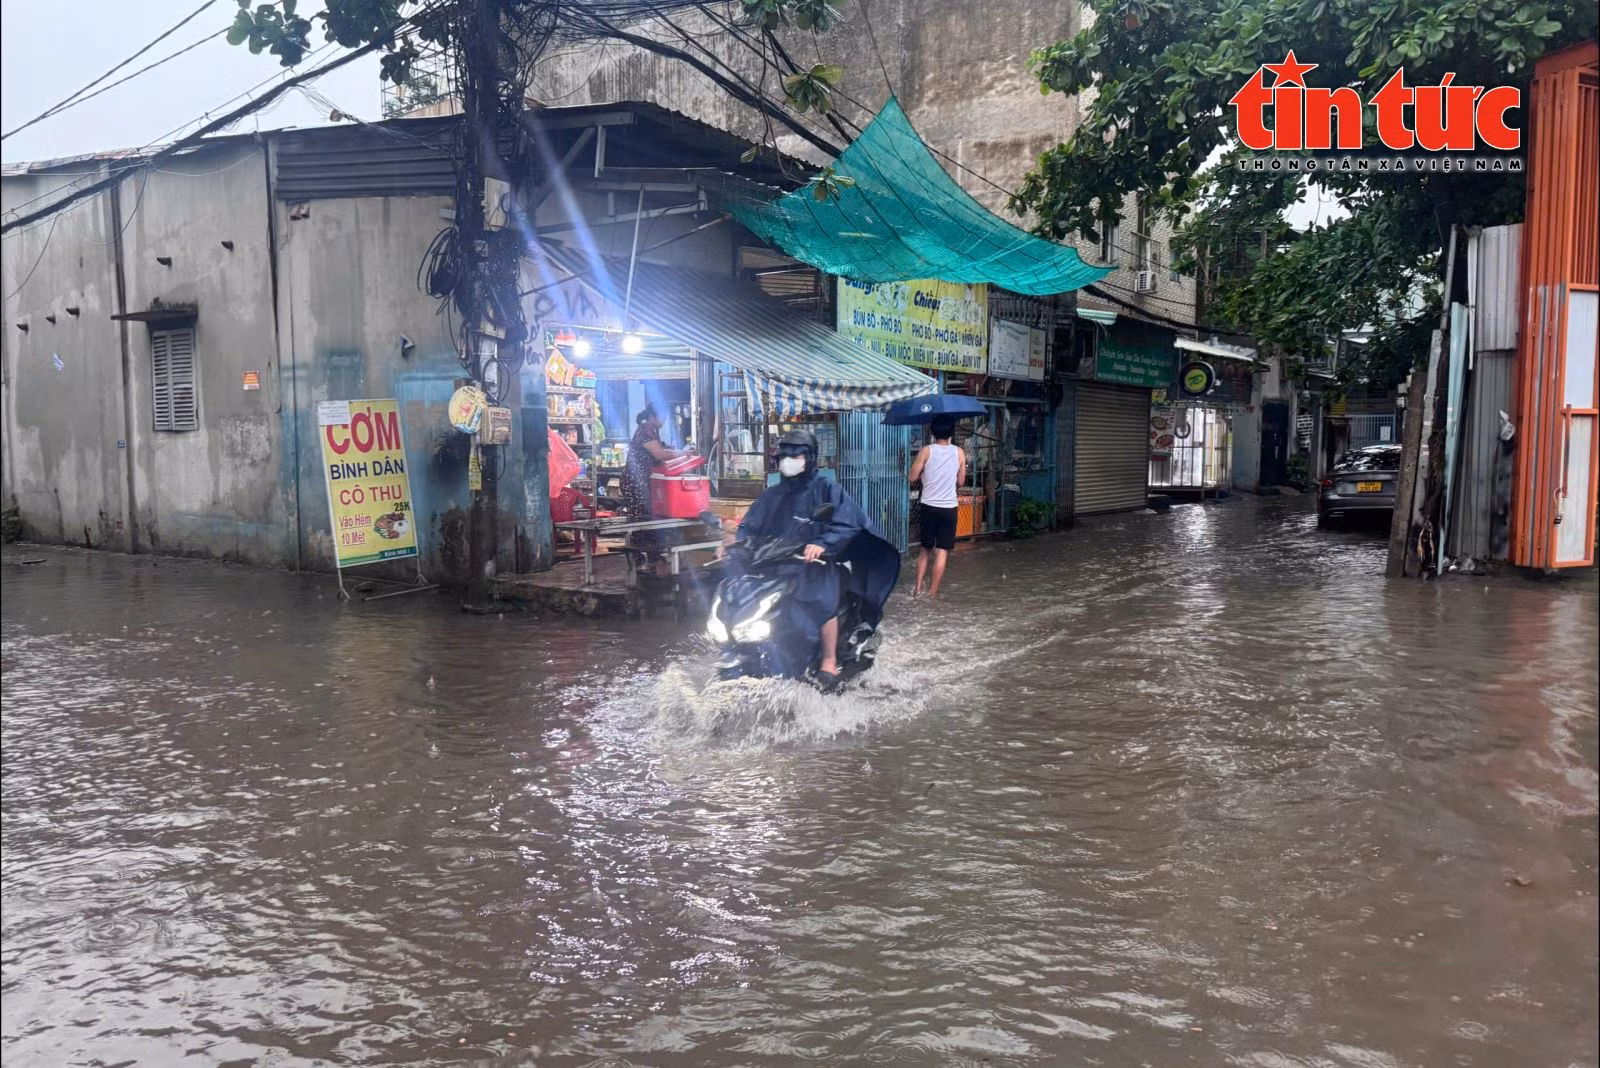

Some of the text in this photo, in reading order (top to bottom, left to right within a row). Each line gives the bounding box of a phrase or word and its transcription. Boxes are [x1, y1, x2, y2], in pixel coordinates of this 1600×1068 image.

[327, 406, 401, 455] CƠM
[330, 455, 405, 480] BÌNH DÂN
[340, 484, 402, 505] CÔ THU
[393, 501, 410, 512] 25K
[341, 532, 350, 545] 10
